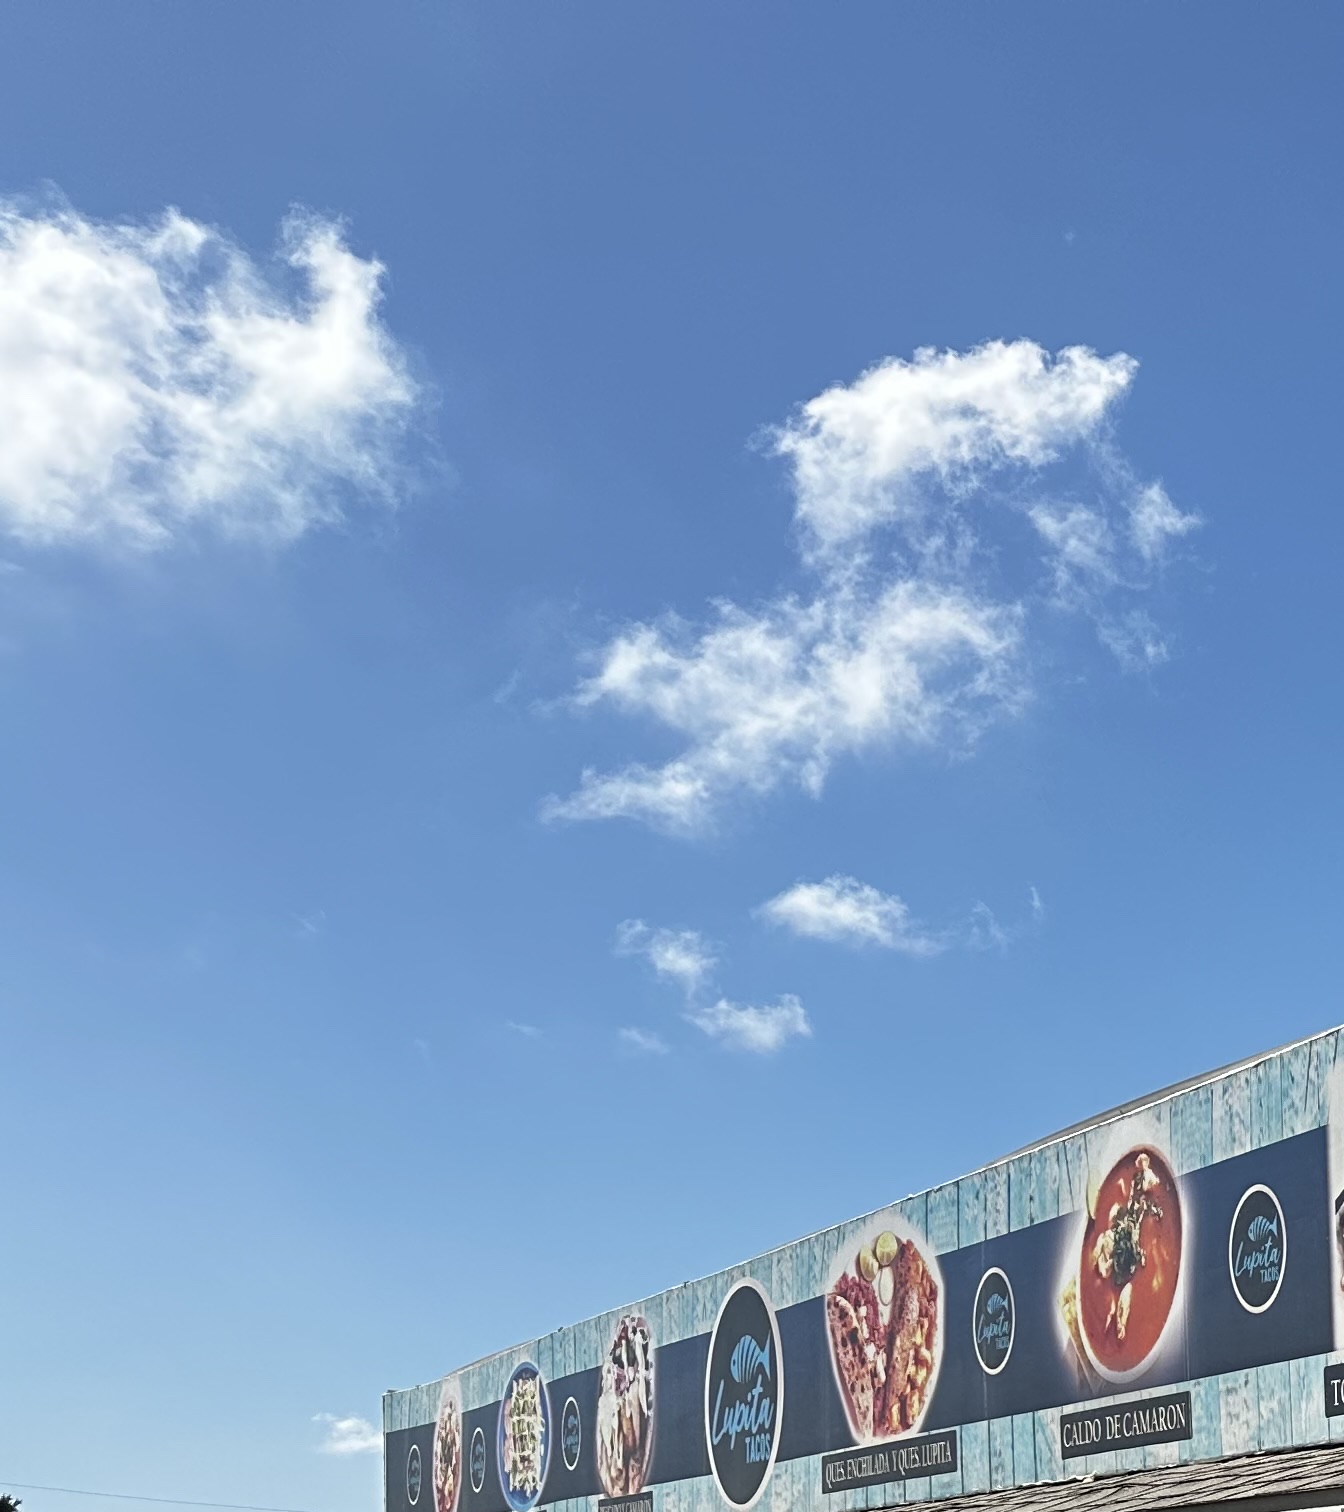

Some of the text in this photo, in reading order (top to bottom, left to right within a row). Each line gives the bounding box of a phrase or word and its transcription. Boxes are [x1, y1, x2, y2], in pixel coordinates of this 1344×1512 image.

[1235, 1236, 1281, 1278] Lupita
[1260, 1266, 1280, 1283] TACOS
[712, 1374, 774, 1450] Lupita
[1063, 1402, 1186, 1448] CALDO DE CAMARON
[745, 1433, 771, 1464] TACOS
[922, 1440, 953, 1467] LUPITA
